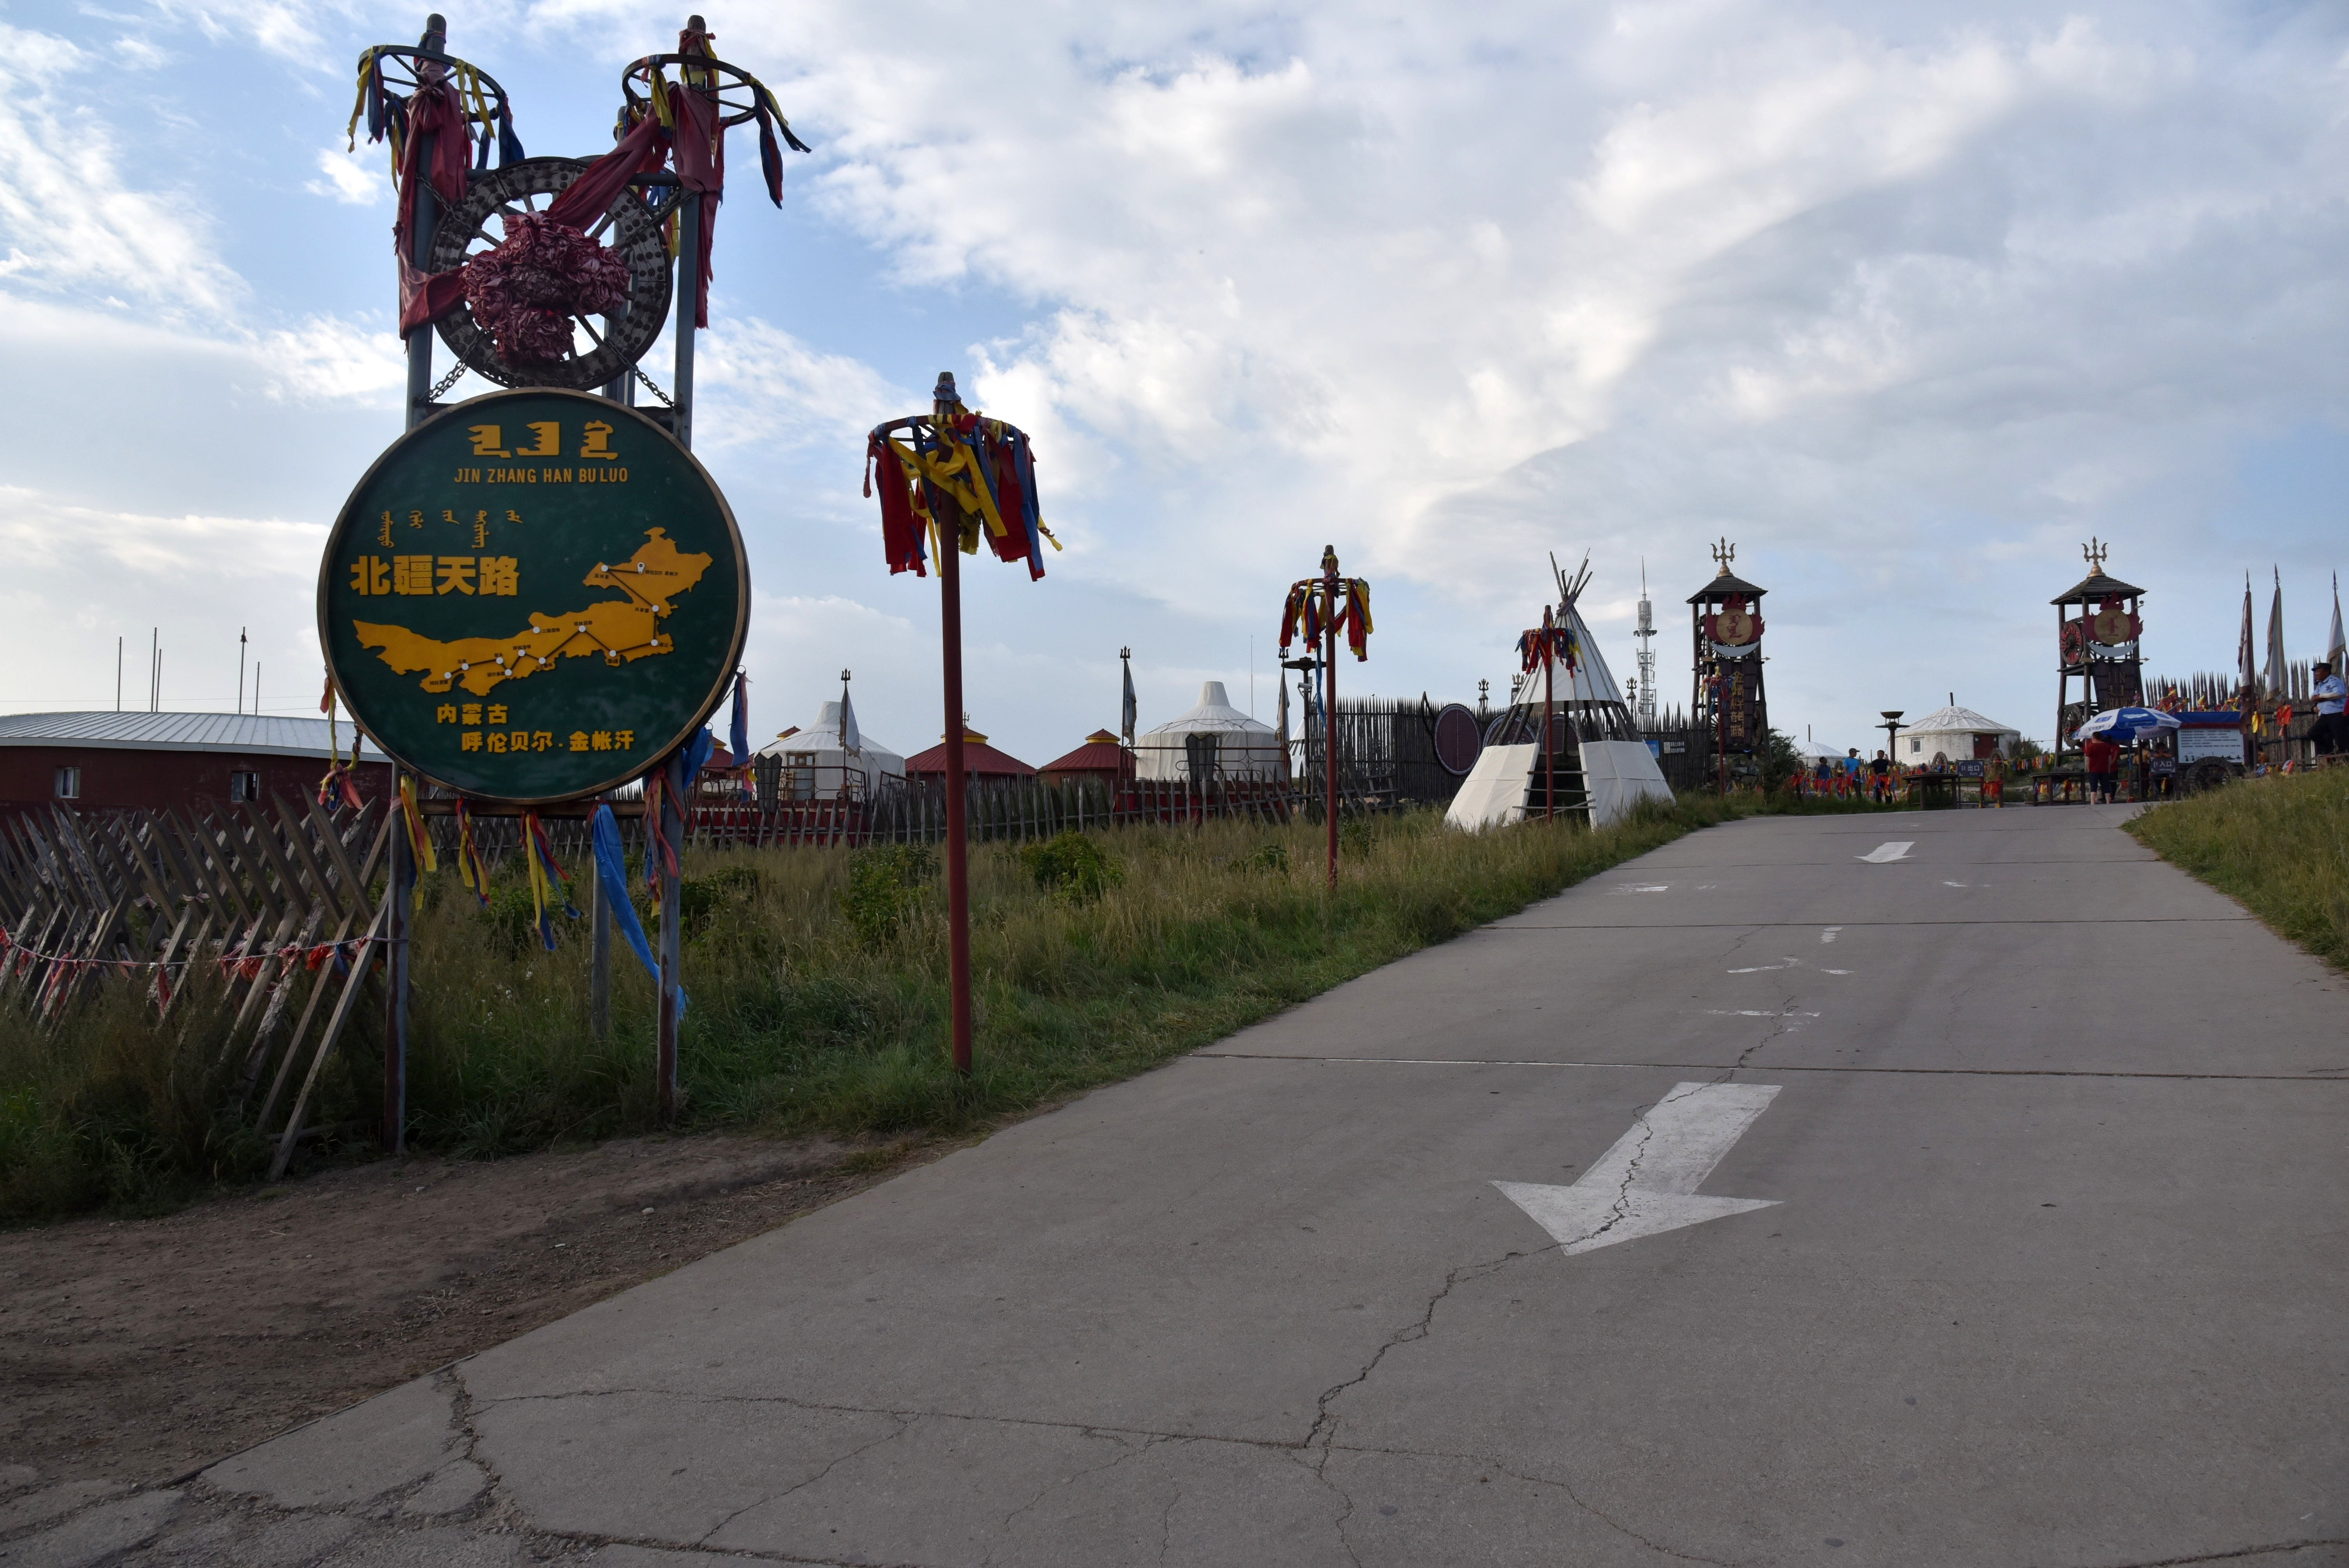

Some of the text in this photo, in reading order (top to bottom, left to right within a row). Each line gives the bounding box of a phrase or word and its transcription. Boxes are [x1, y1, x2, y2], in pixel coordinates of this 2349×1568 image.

[454, 468, 480, 483] JIN
[488, 469, 536, 483] ZHANG
[543, 469, 572, 483] HAN
[350, 555, 520, 596] 北疆天路
[2107, 672, 2126, 683] JIN
[2104, 697, 2132, 710] ZHANG
[437, 703, 508, 725] 内蒙古
